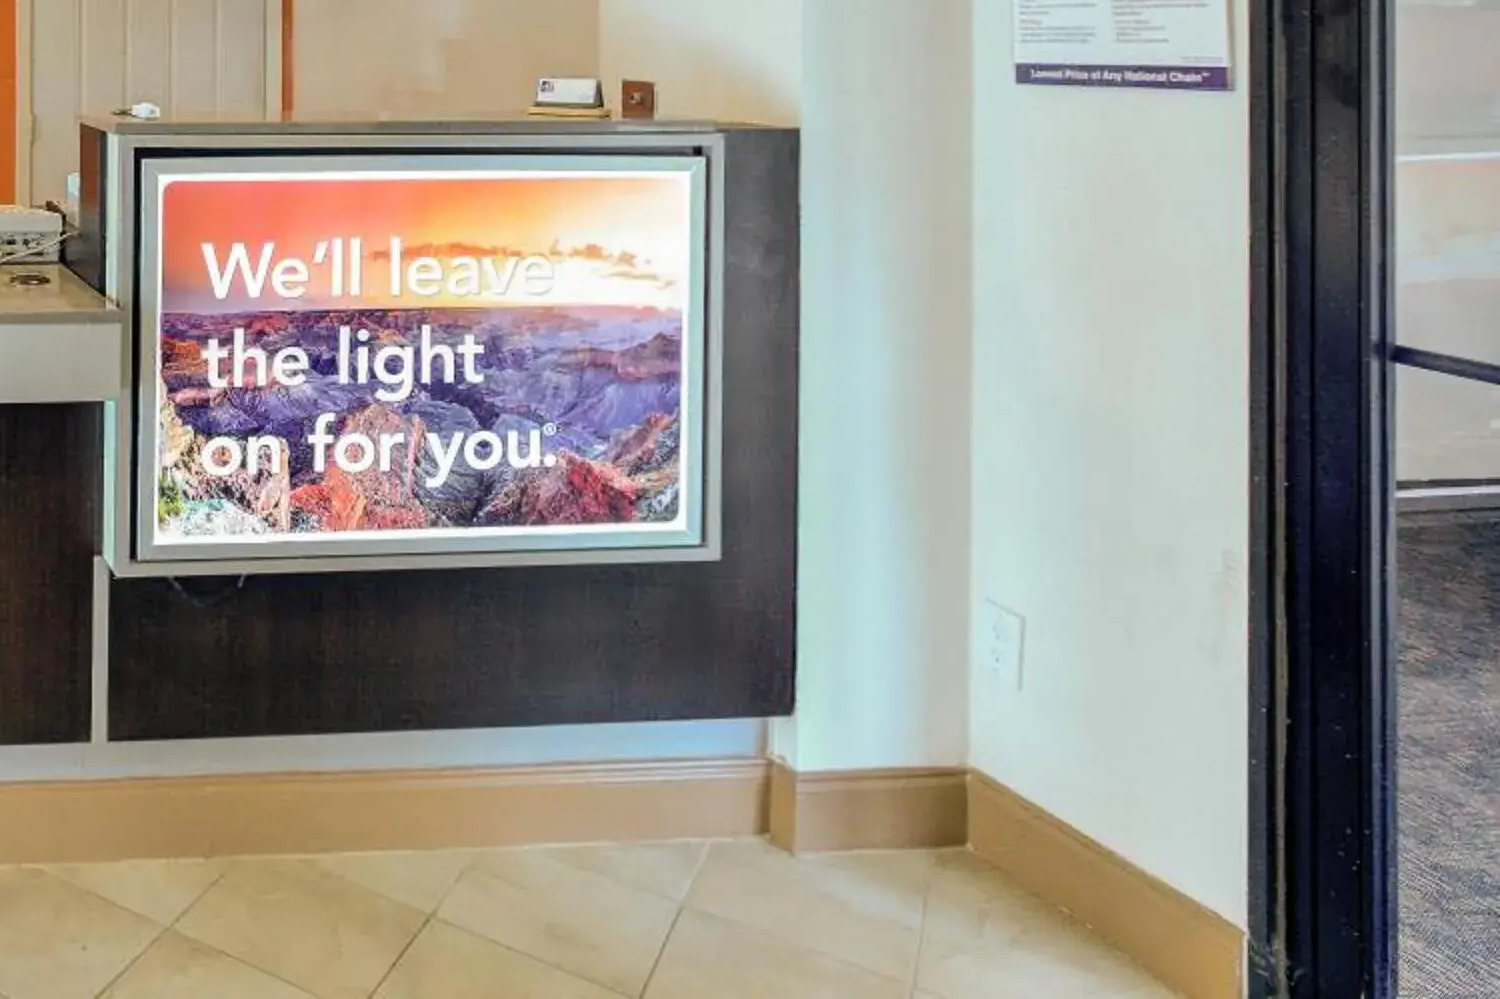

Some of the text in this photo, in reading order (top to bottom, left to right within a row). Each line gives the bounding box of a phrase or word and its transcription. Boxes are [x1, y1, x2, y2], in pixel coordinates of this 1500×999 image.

[390, 237, 556, 298] leave
[202, 325, 486, 401] the light
[201, 439, 281, 476] on
[308, 413, 403, 472] for
